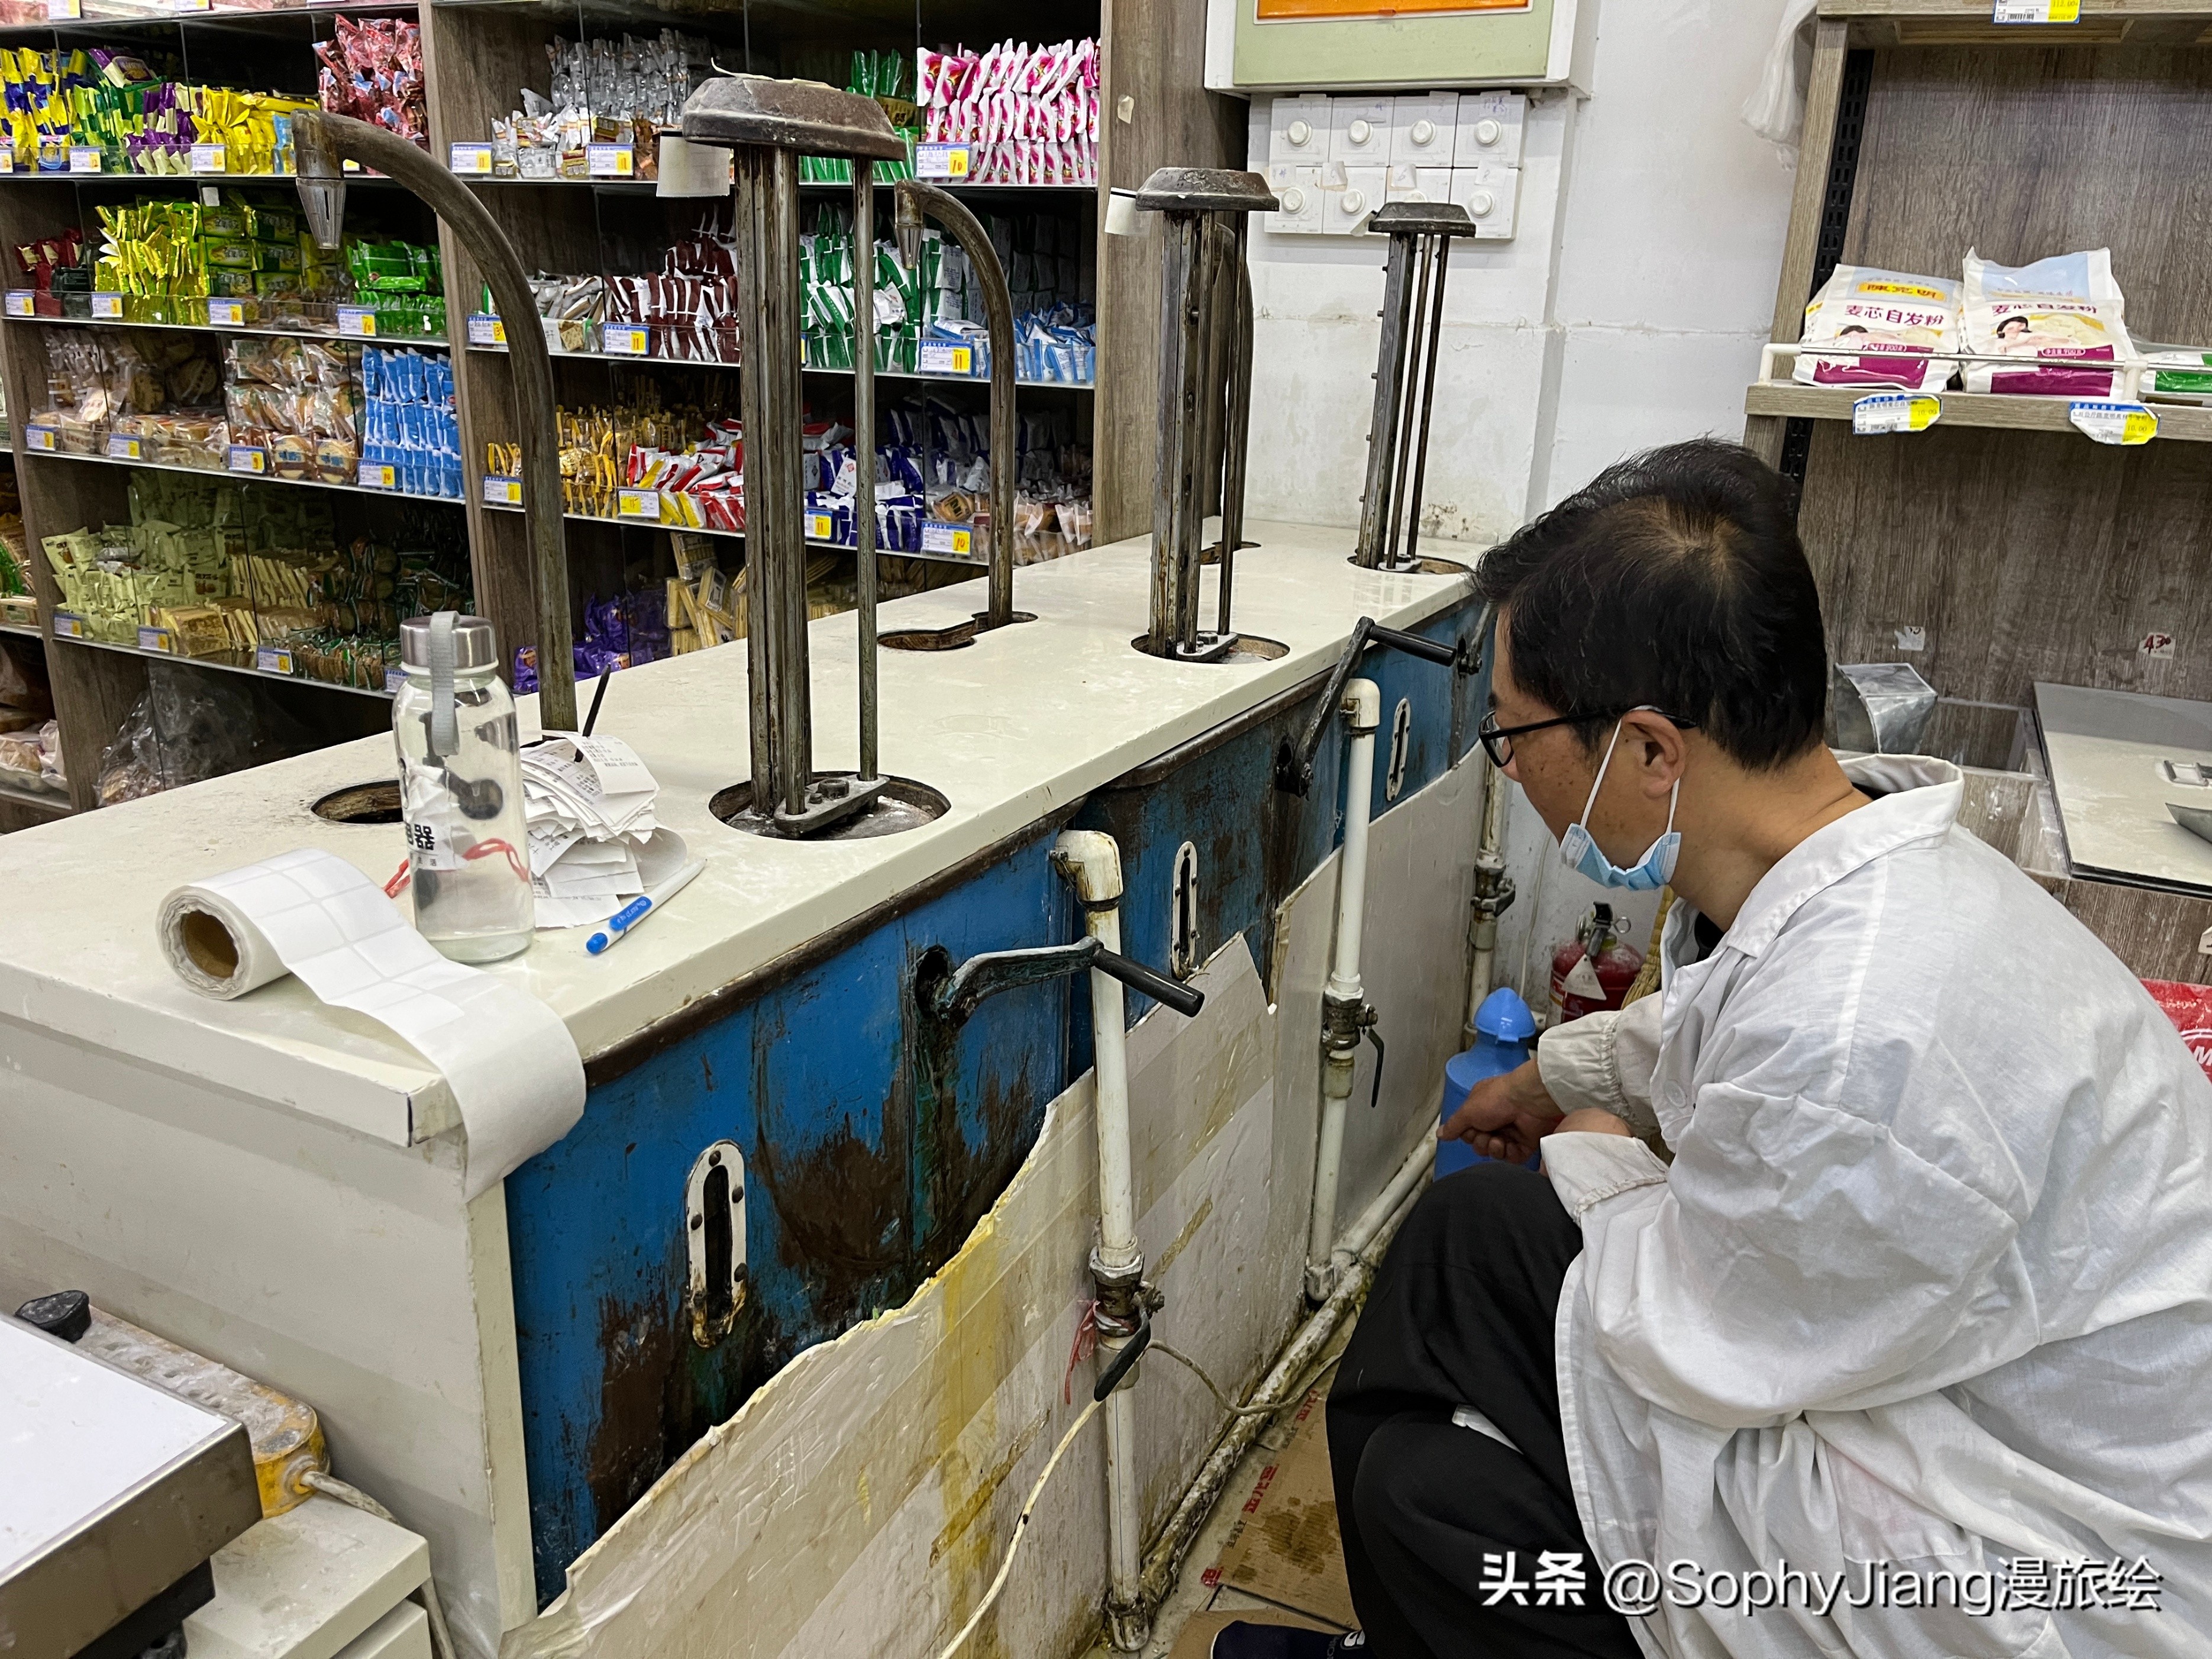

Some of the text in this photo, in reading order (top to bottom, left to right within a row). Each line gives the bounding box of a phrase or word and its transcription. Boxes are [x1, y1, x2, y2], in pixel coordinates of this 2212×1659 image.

[952, 160, 963, 174] 10
[1844, 305, 1945, 327] 麦芯自发粉
[954, 354, 962, 370] 11
